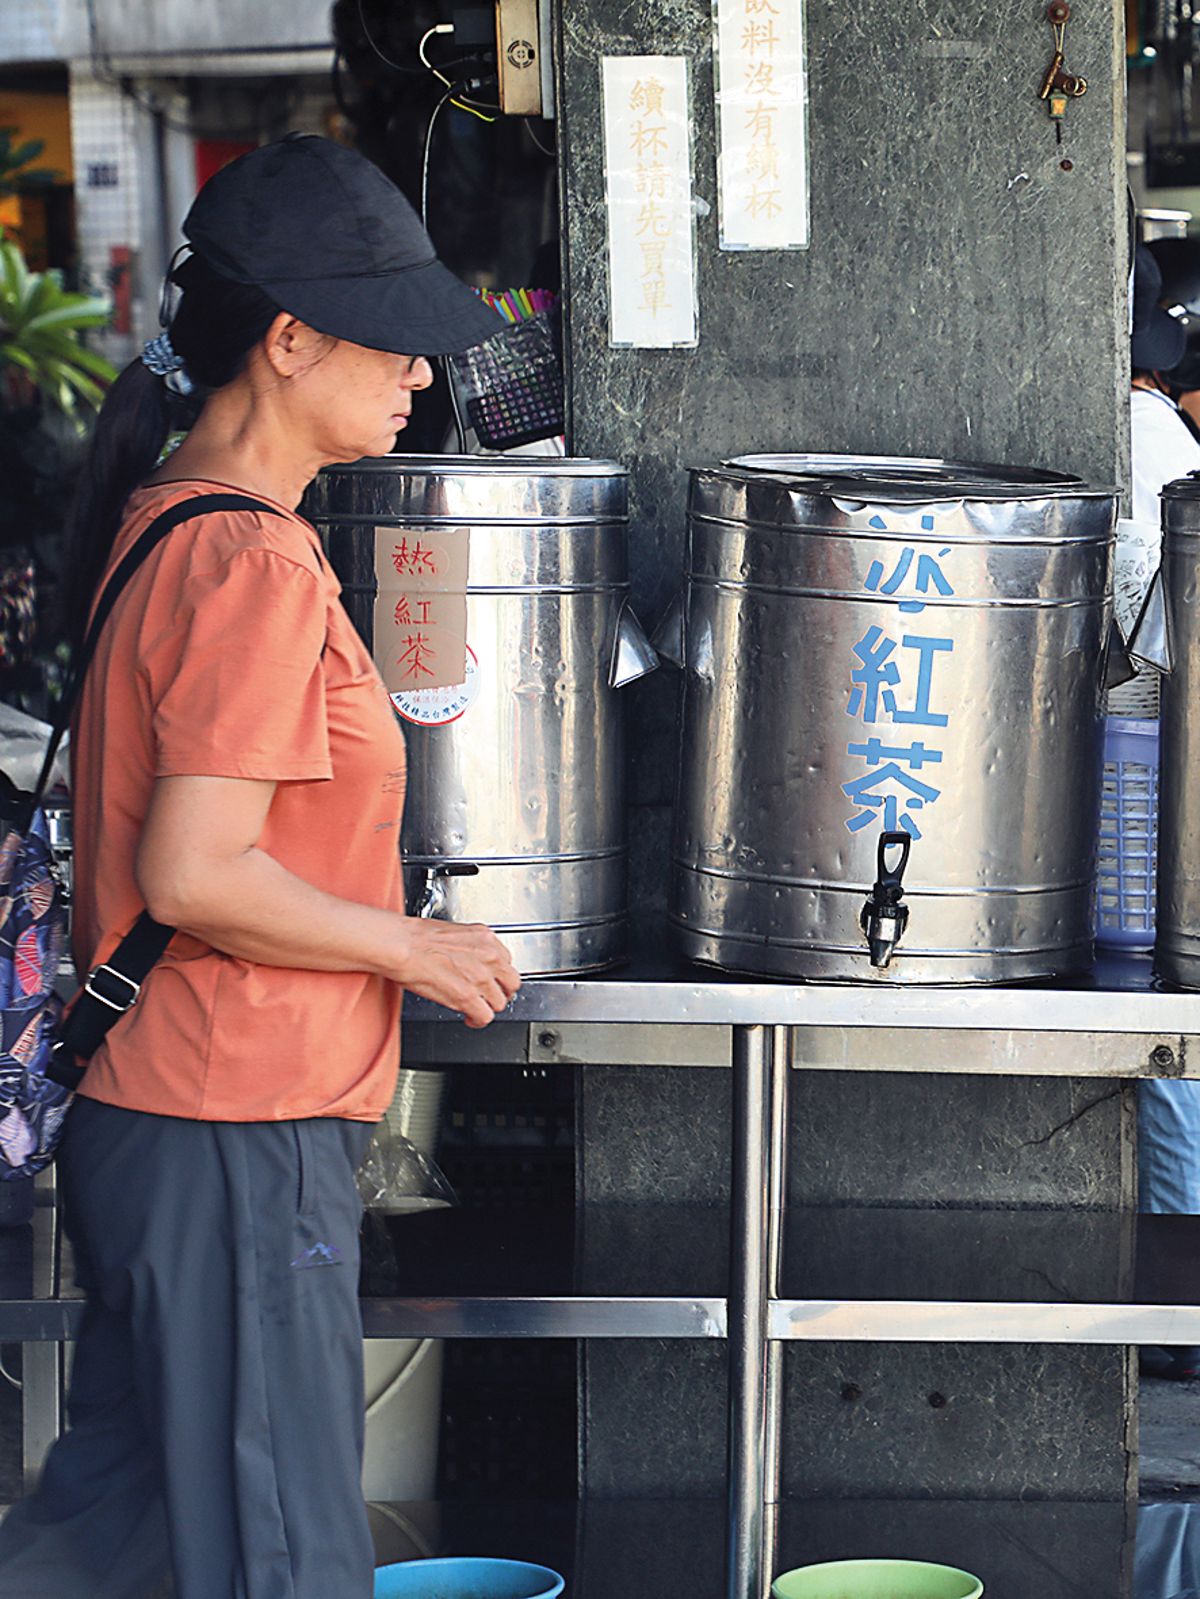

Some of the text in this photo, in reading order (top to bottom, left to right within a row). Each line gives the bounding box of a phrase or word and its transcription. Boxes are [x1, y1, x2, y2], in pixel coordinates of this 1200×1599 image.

[629, 76, 673, 319] 續杯請先買單
[391, 537, 438, 680] 熱紅茶
[841, 515, 956, 849] 冰紅茶
